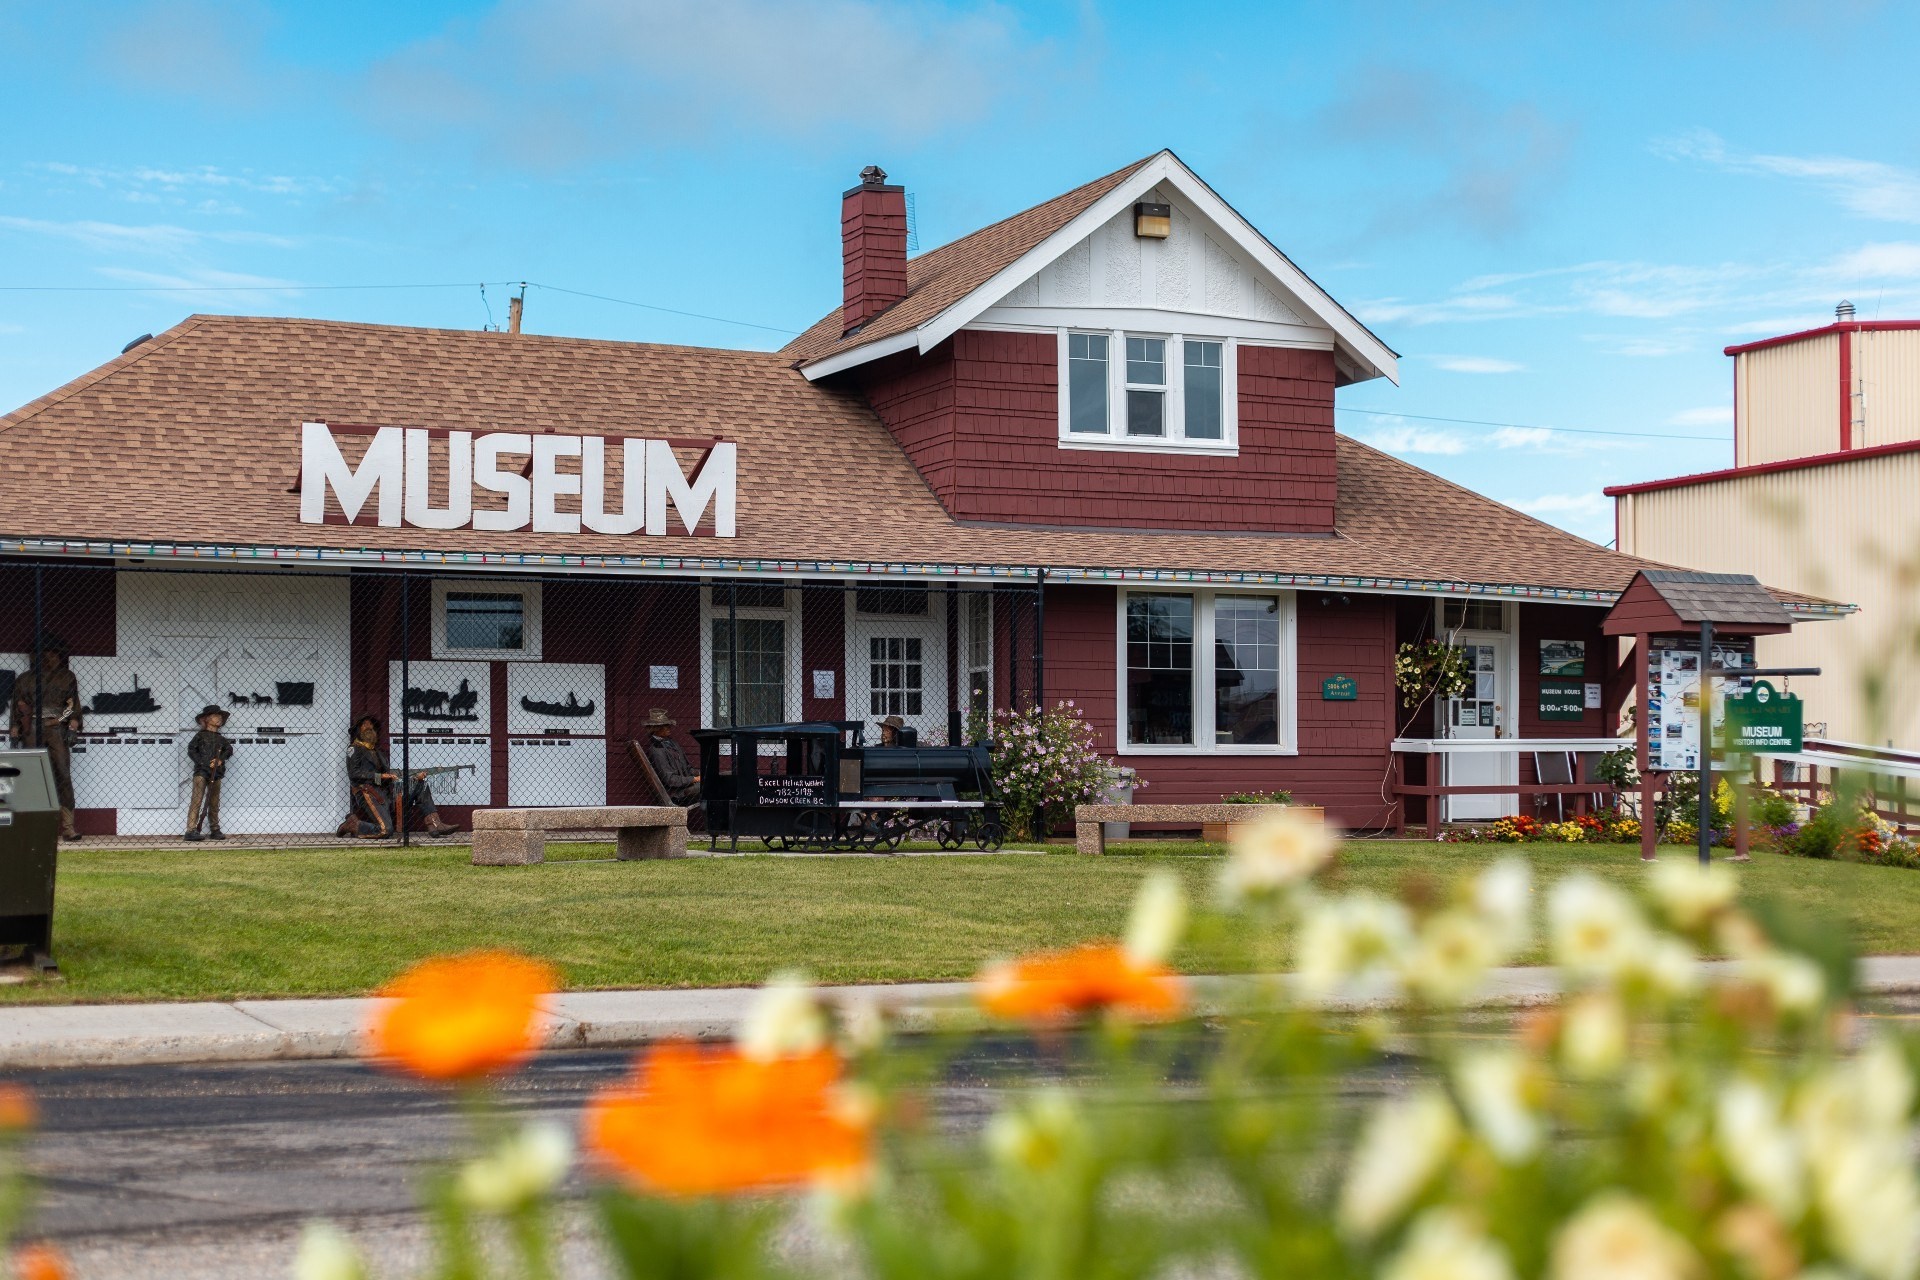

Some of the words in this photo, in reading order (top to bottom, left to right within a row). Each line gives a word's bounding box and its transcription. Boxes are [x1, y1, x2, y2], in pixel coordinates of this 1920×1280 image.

[300, 422, 737, 538] MUSEUM
[1742, 726, 1783, 738] MUSEUM
[759, 795, 789, 805] DAWSON
[789, 796, 811, 805] CREEK
[813, 797, 824, 805] BC
